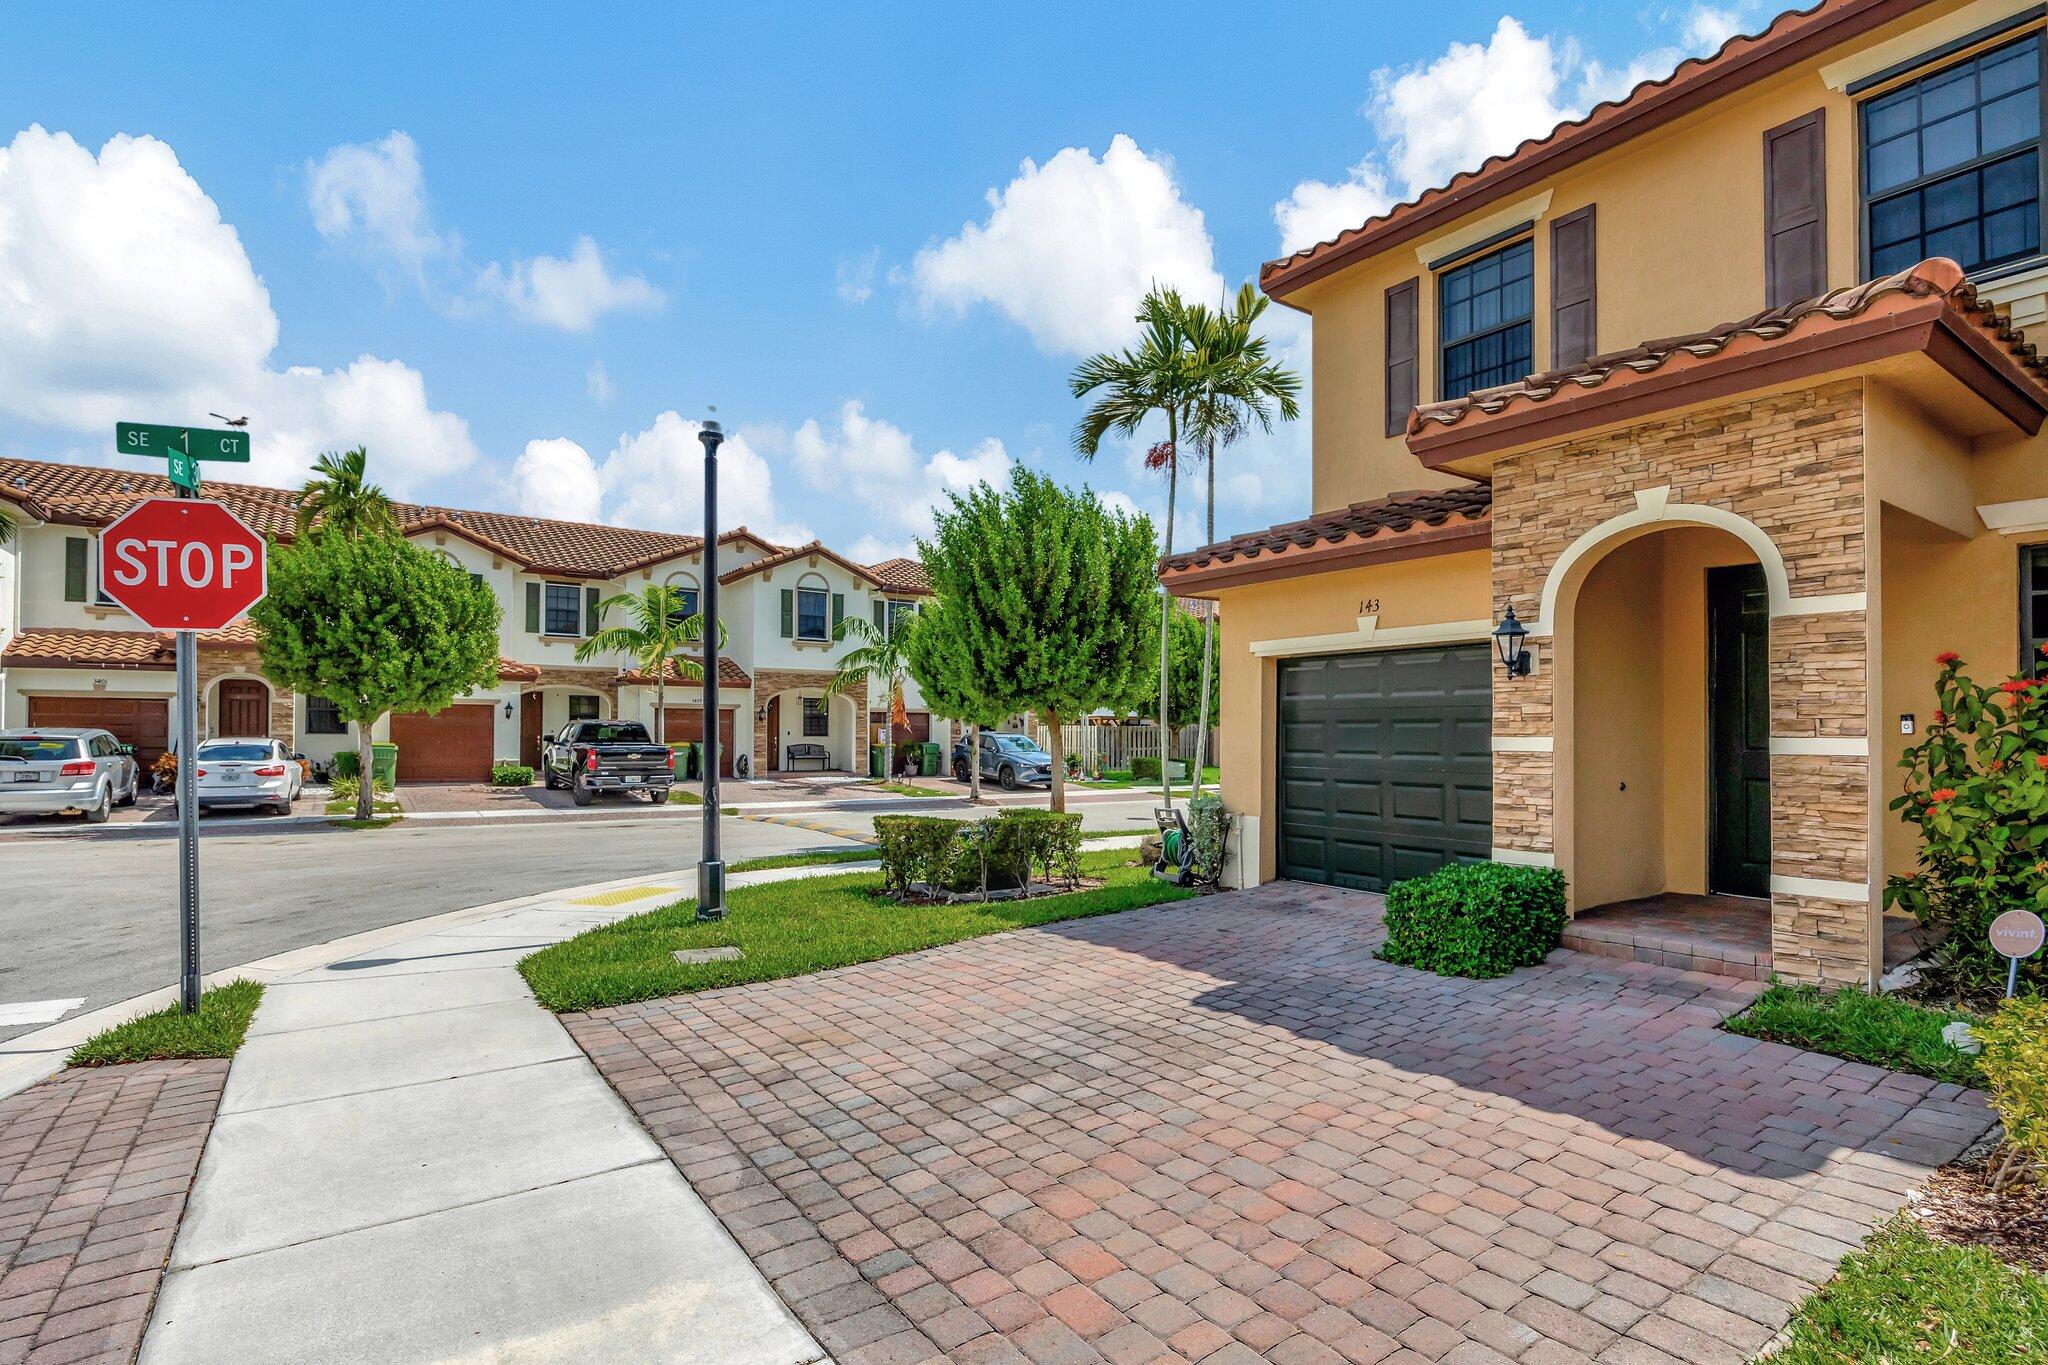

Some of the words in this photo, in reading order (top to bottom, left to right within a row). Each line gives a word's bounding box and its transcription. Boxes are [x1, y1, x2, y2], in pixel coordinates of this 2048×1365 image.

[128, 431, 149, 447] SE
[180, 430, 189, 455] 1
[220, 439, 239, 453] CT
[173, 459, 184, 476] SE
[113, 538, 254, 589] STOP
[1359, 599, 1379, 614] 143
